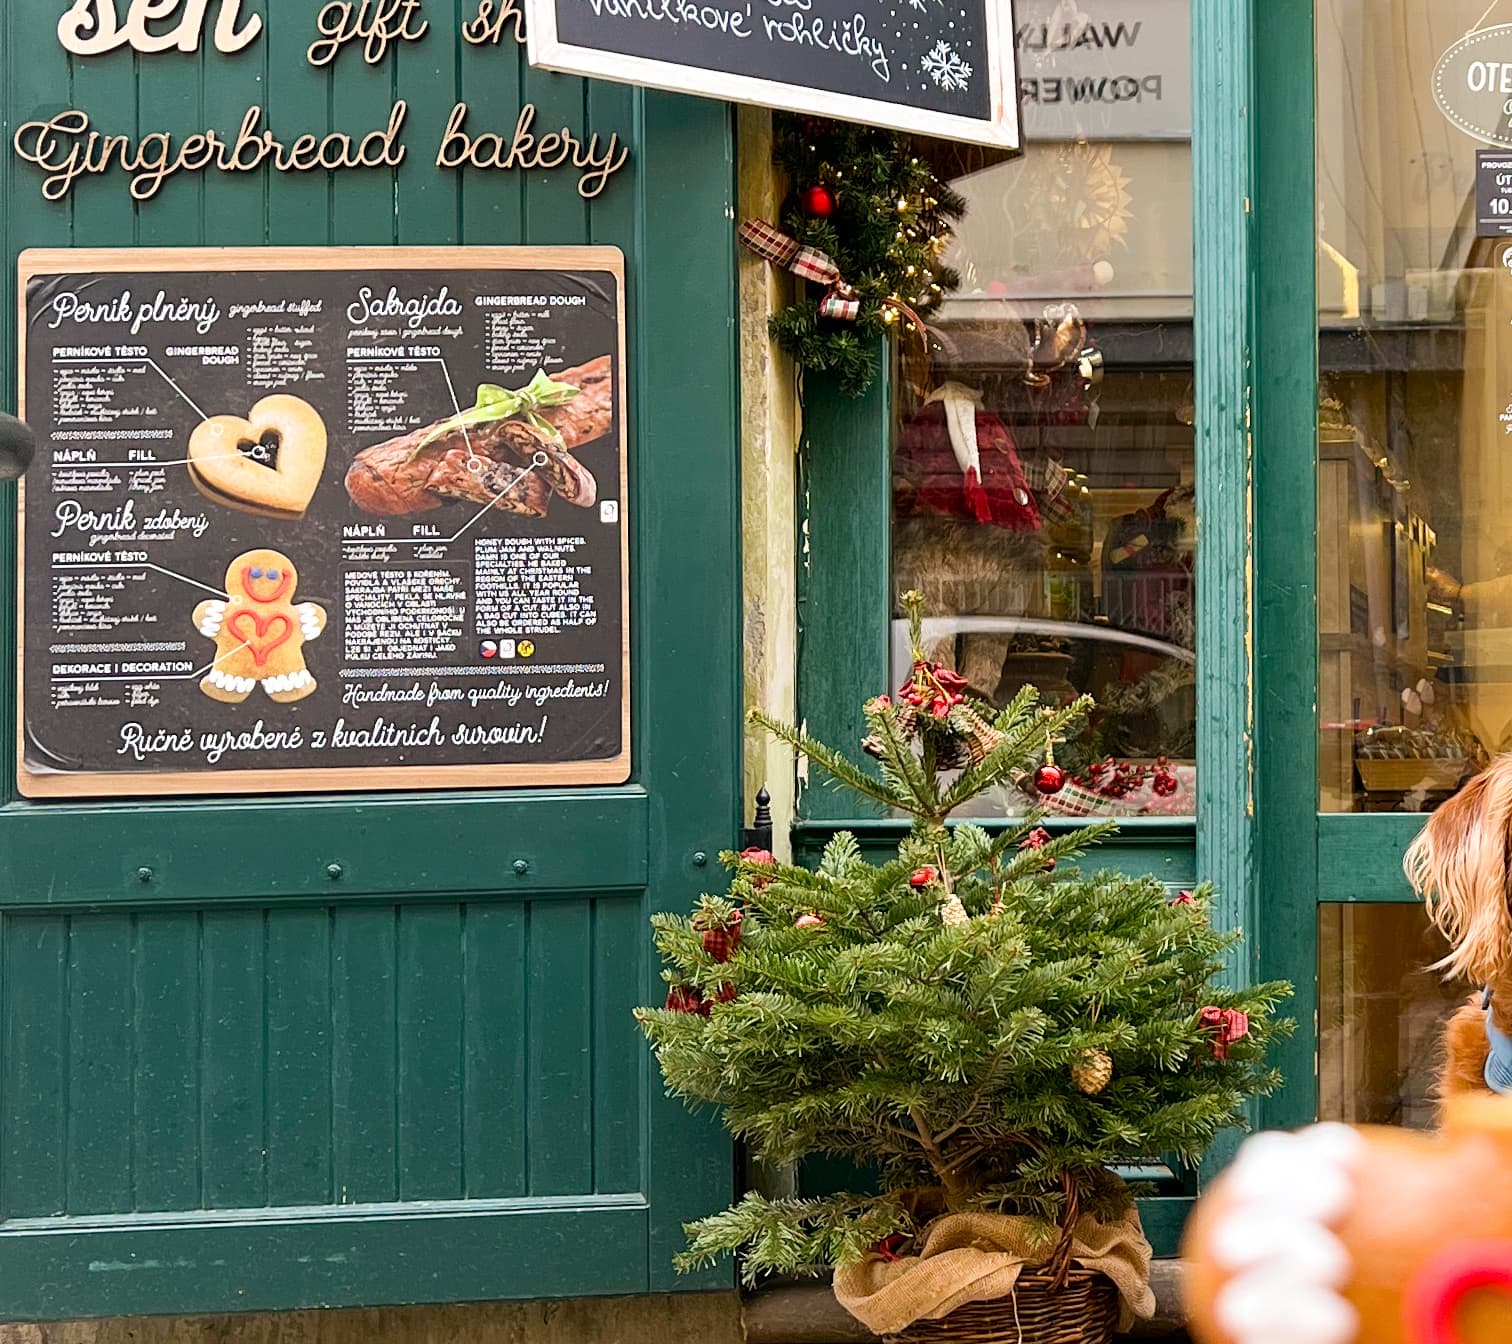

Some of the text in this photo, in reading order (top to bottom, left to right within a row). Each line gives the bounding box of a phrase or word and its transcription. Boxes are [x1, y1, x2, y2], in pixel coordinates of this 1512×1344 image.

[14, 100, 630, 201] Gingerbread bakery
[130, 290, 221, 335] plněný
[347, 287, 586, 328] Sakrajda GINGERBREAD DOUGH
[52, 345, 239, 357] PERNÍKOVÉ TĚSTO GINGERBREAD
[347, 346, 441, 357] PERNÍKOVÉ TĚSTO
[202, 355, 239, 365] DOUGH
[53, 448, 156, 462] NÁPLŇ FILL
[143, 509, 209, 538] zdobený
[343, 524, 440, 536] NÁPLŇ FILL
[52, 550, 148, 563] PERNÍKOVÉ TĚSTO
[52, 661, 193, 674] DEKORACE DECORATION
[343, 679, 610, 709] Handmade from quality ingredients!
[117, 715, 548, 763] Ručně vyrobené z kvalitních surovin!
